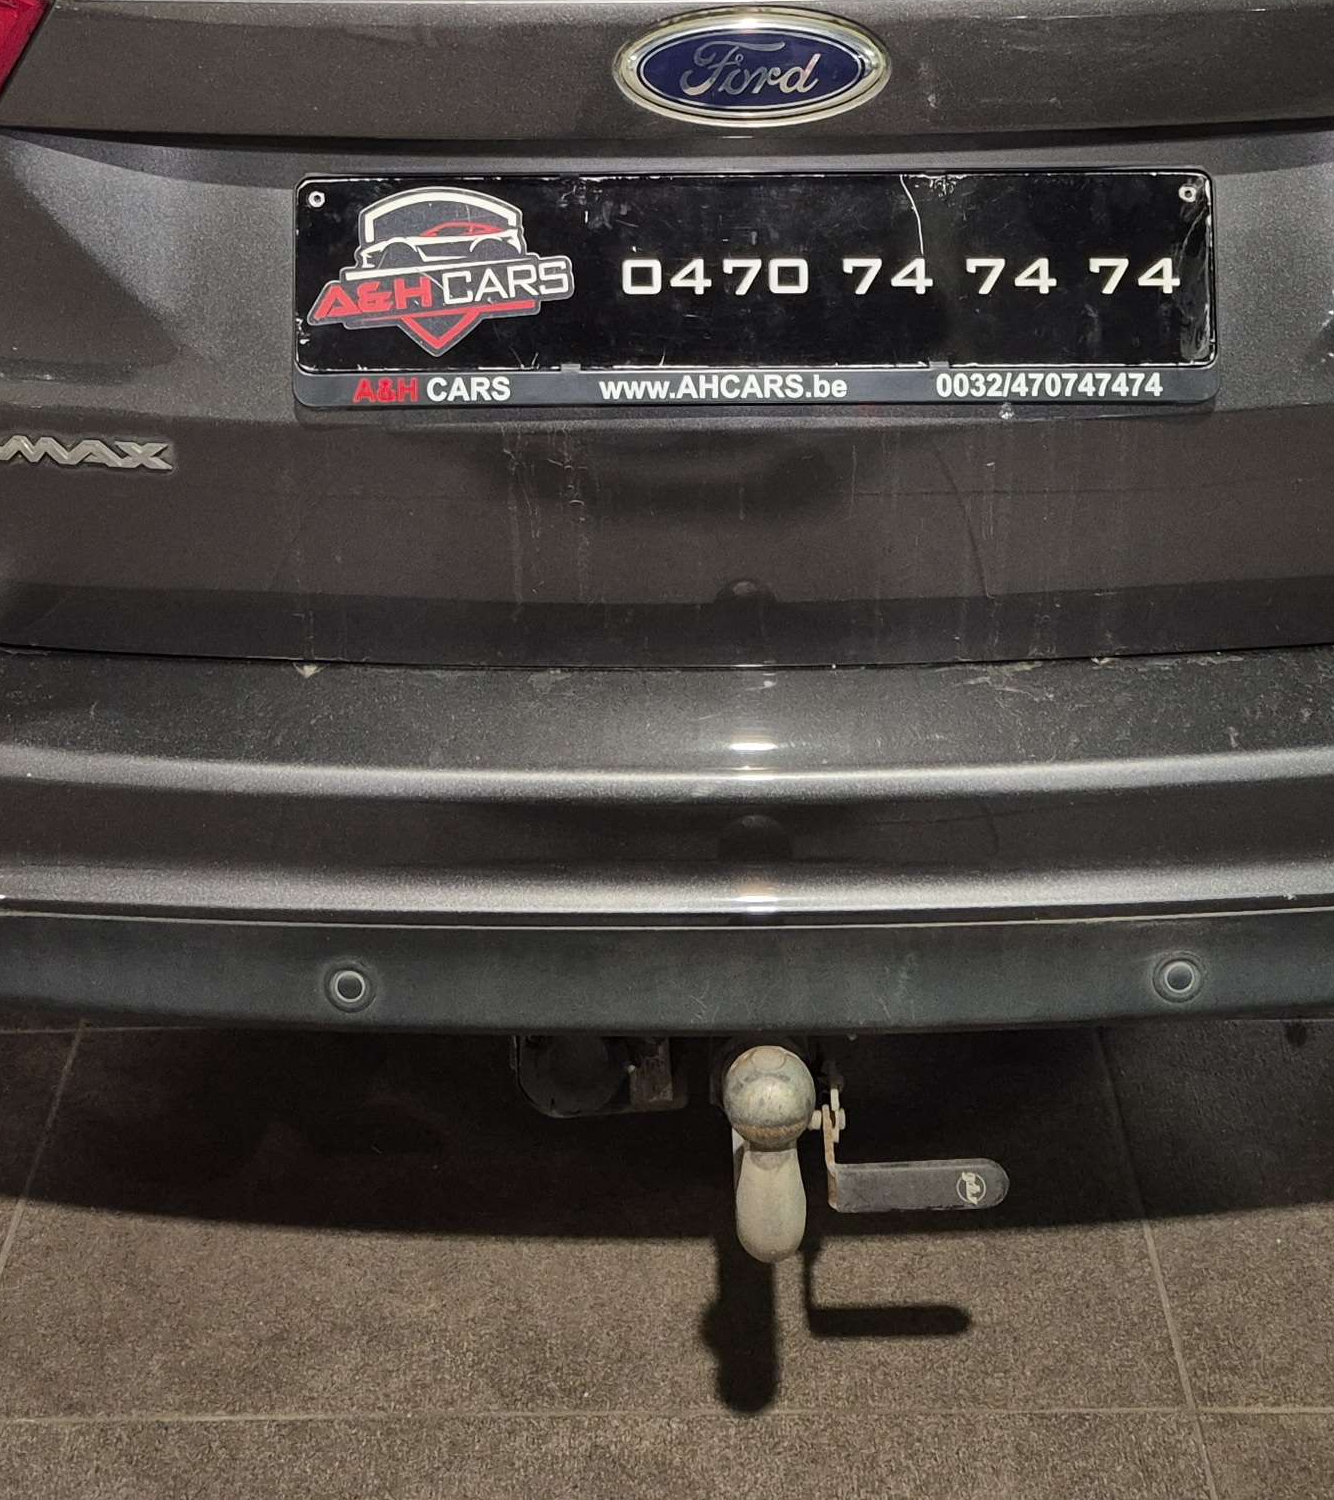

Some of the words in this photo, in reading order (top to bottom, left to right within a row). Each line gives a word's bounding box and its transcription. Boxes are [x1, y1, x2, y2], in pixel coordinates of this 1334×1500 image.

[679, 41, 820, 97] Ford
[314, 275, 434, 321] A&H
[441, 260, 569, 306] CARS
[622, 258, 809, 296] 0470
[842, 257, 934, 295] 74
[966, 257, 1058, 295] 74
[1089, 257, 1181, 295] 74
[352, 377, 420, 403] A&H
[426, 376, 512, 402] CARS
[598, 372, 847, 401] www.AHCARS.be
[935, 372, 1164, 399] 0032/470747474
